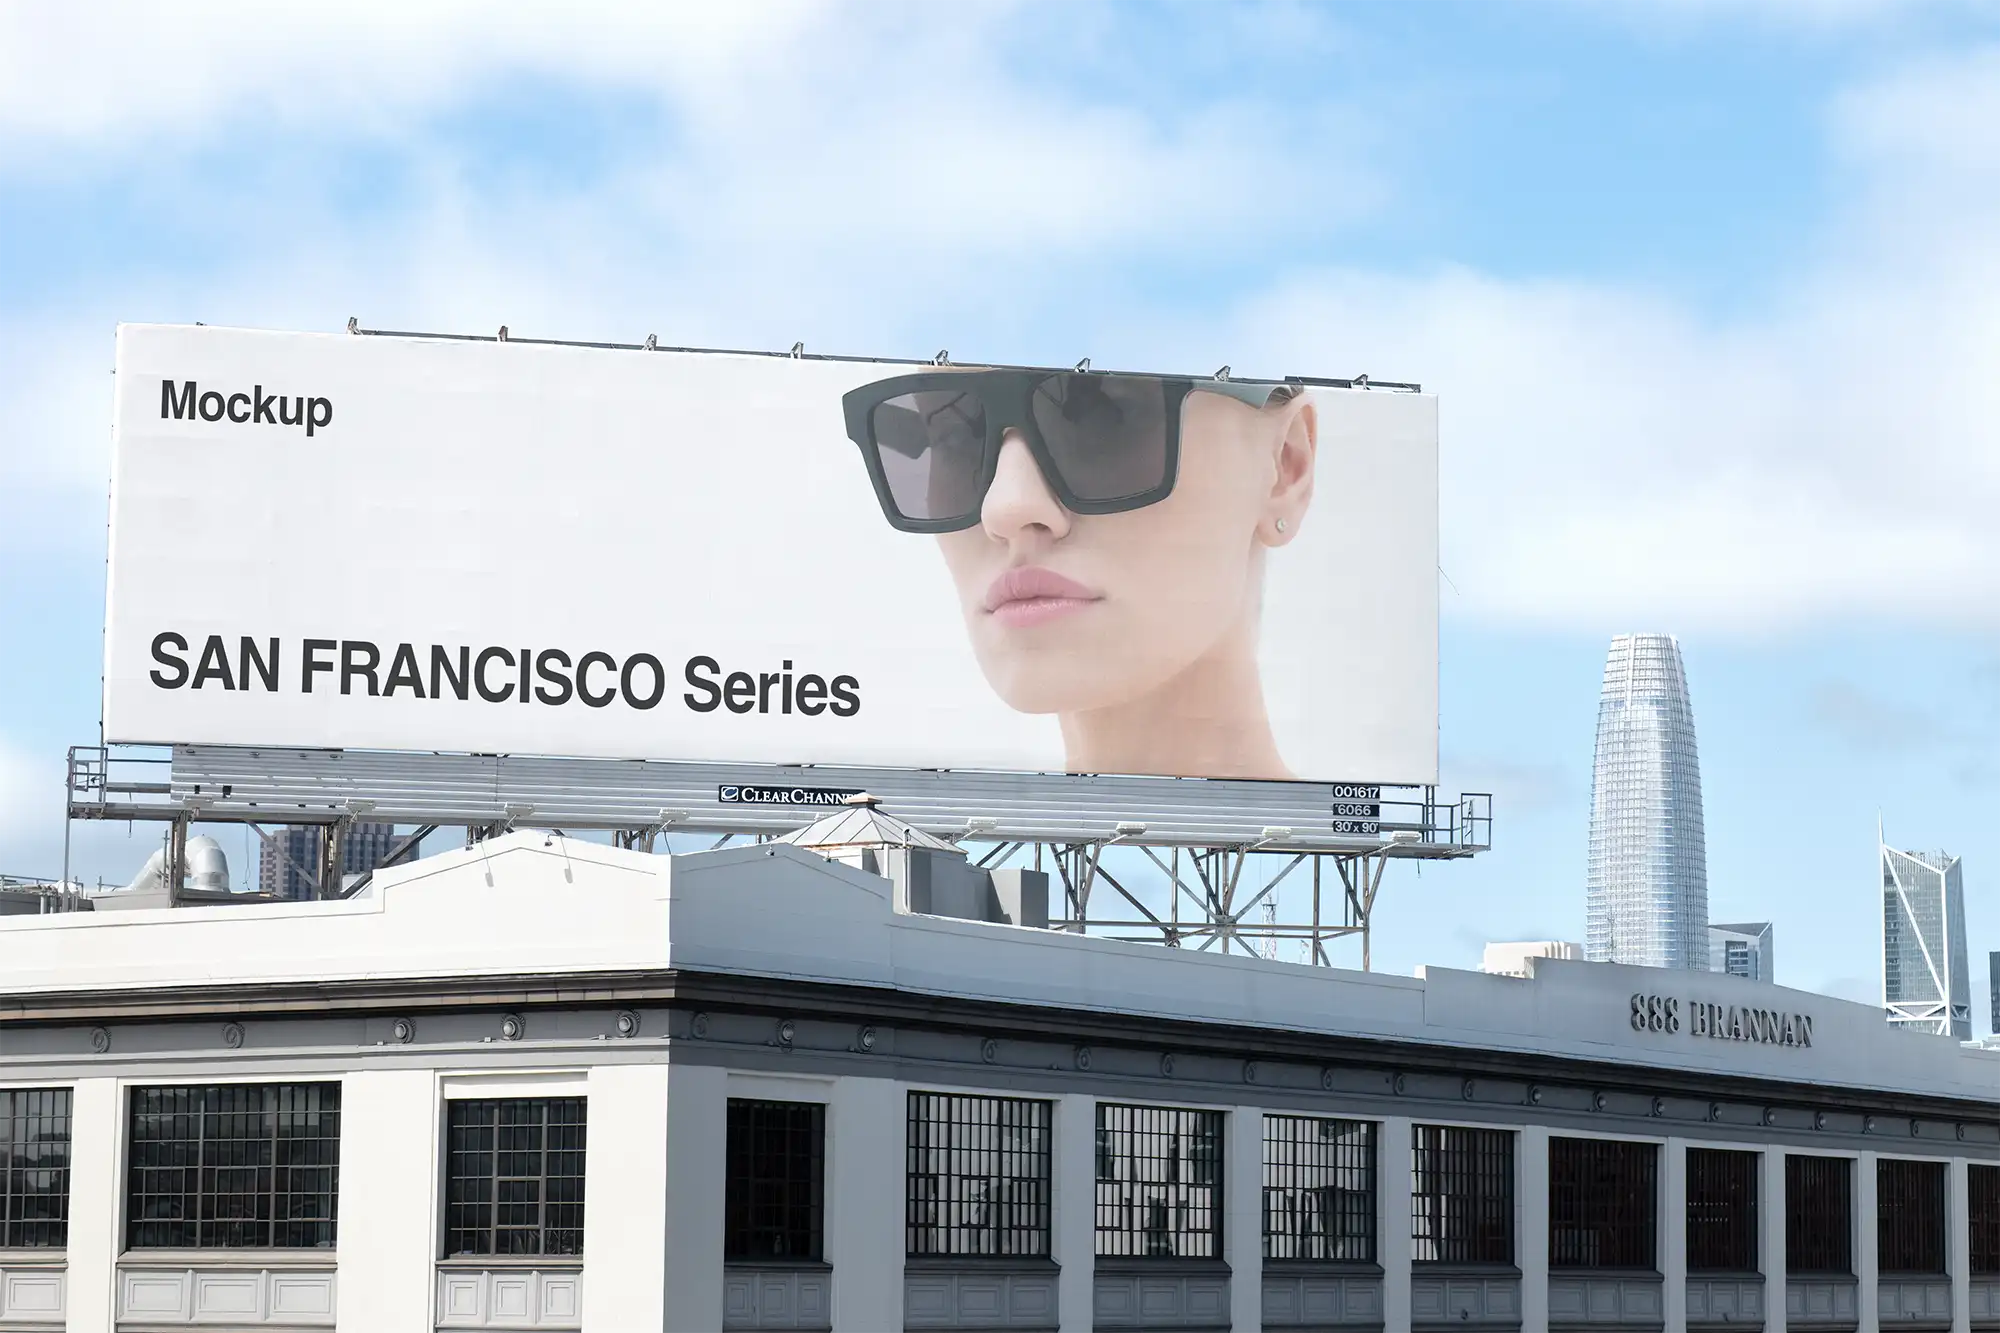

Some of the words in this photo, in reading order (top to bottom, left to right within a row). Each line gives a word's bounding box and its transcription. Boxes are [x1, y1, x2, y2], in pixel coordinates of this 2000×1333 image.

[161, 380, 332, 437] Mockup
[150, 632, 279, 692] SAN
[302, 639, 666, 710] FRANCISCO
[684, 656, 860, 716] Series
[1335, 786, 1379, 798] 001617
[1630, 993, 1680, 1035] 888
[1690, 1002, 1813, 1047] BRANNAN
